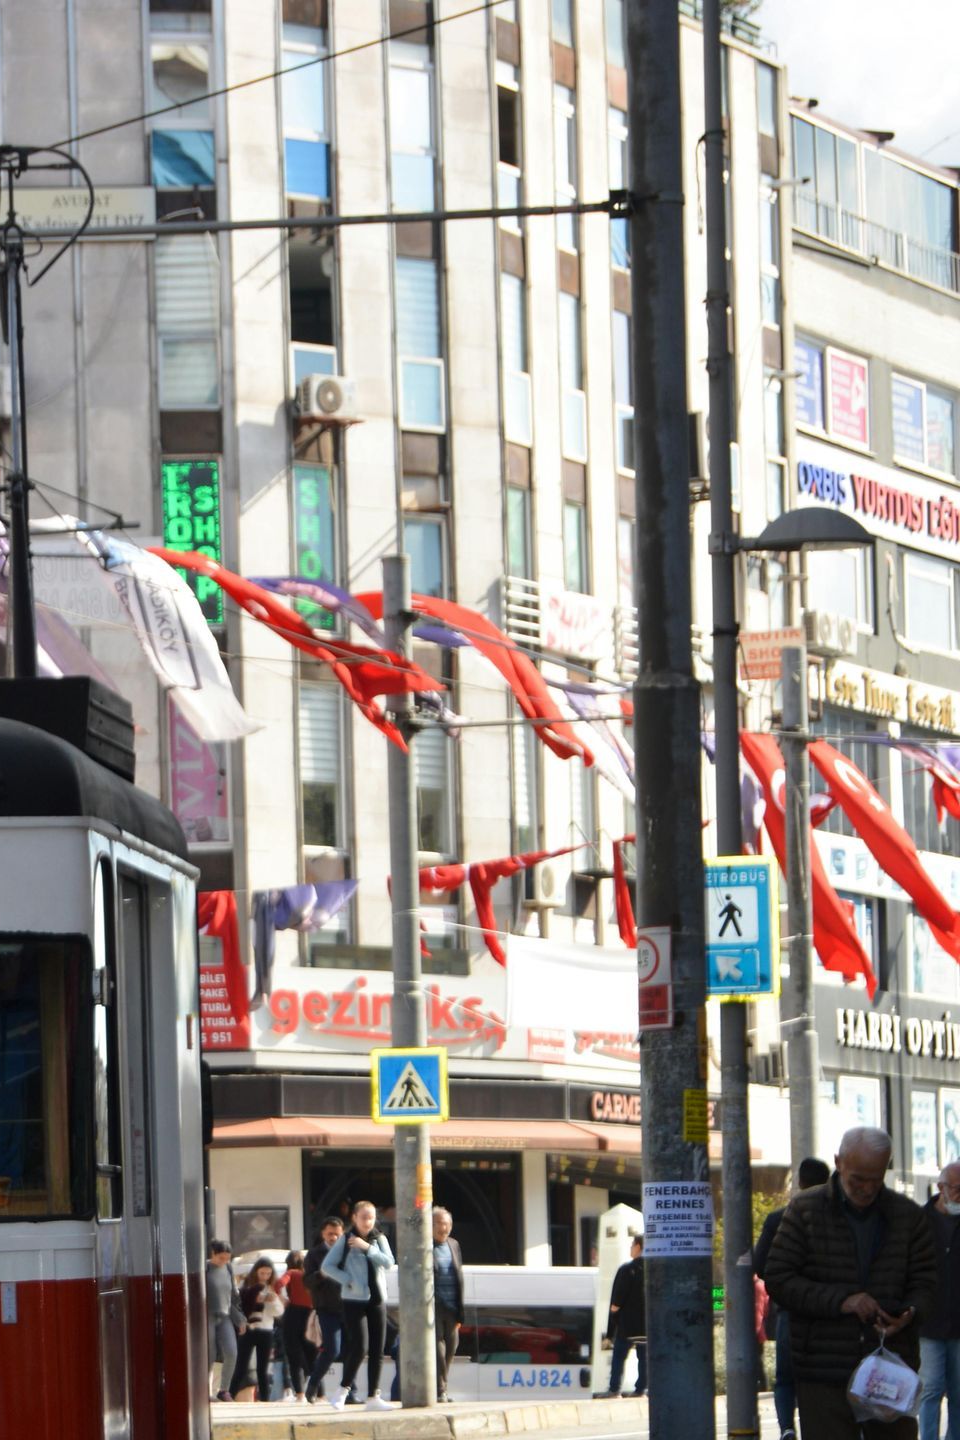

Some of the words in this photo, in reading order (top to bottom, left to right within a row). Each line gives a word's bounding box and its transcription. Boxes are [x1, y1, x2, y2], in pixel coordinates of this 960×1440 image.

[171, 704, 205, 817] VİZ
[704, 868, 767, 883] ETROBÜS
[836, 1005, 901, 1054] HARBİ
[591, 1091, 642, 1122] CARME
[644, 1185, 712, 1199] FENERBAHÇ
[655, 1199, 705, 1209] RENNES
[497, 1368, 572, 1388] LAJ824
